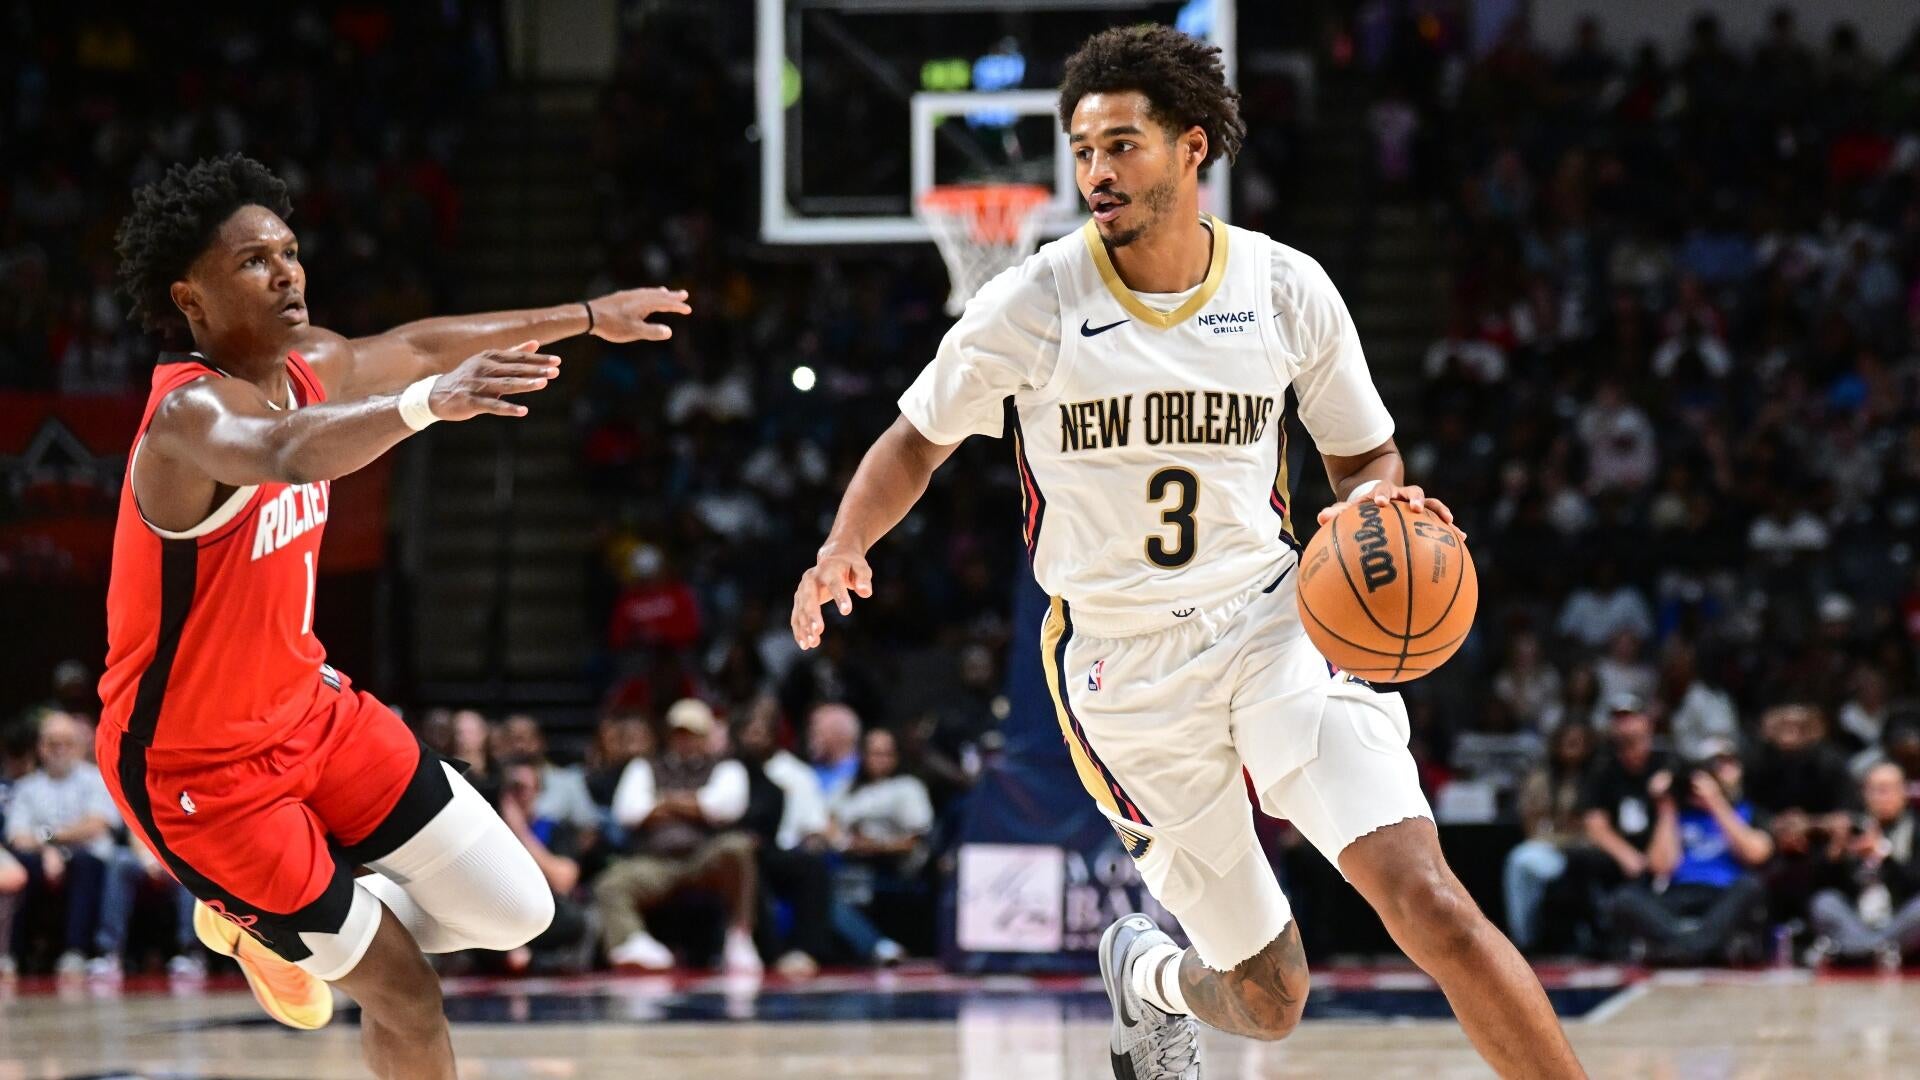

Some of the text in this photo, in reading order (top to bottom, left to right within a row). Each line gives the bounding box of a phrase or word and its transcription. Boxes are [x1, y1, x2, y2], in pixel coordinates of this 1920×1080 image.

[1198, 311, 1256, 327] NEWAGE
[1213, 325, 1244, 334] GRILLS
[1059, 391, 1273, 453] NEW ORLEANS
[1145, 466, 1200, 570] 3
[301, 551, 313, 635] 1
